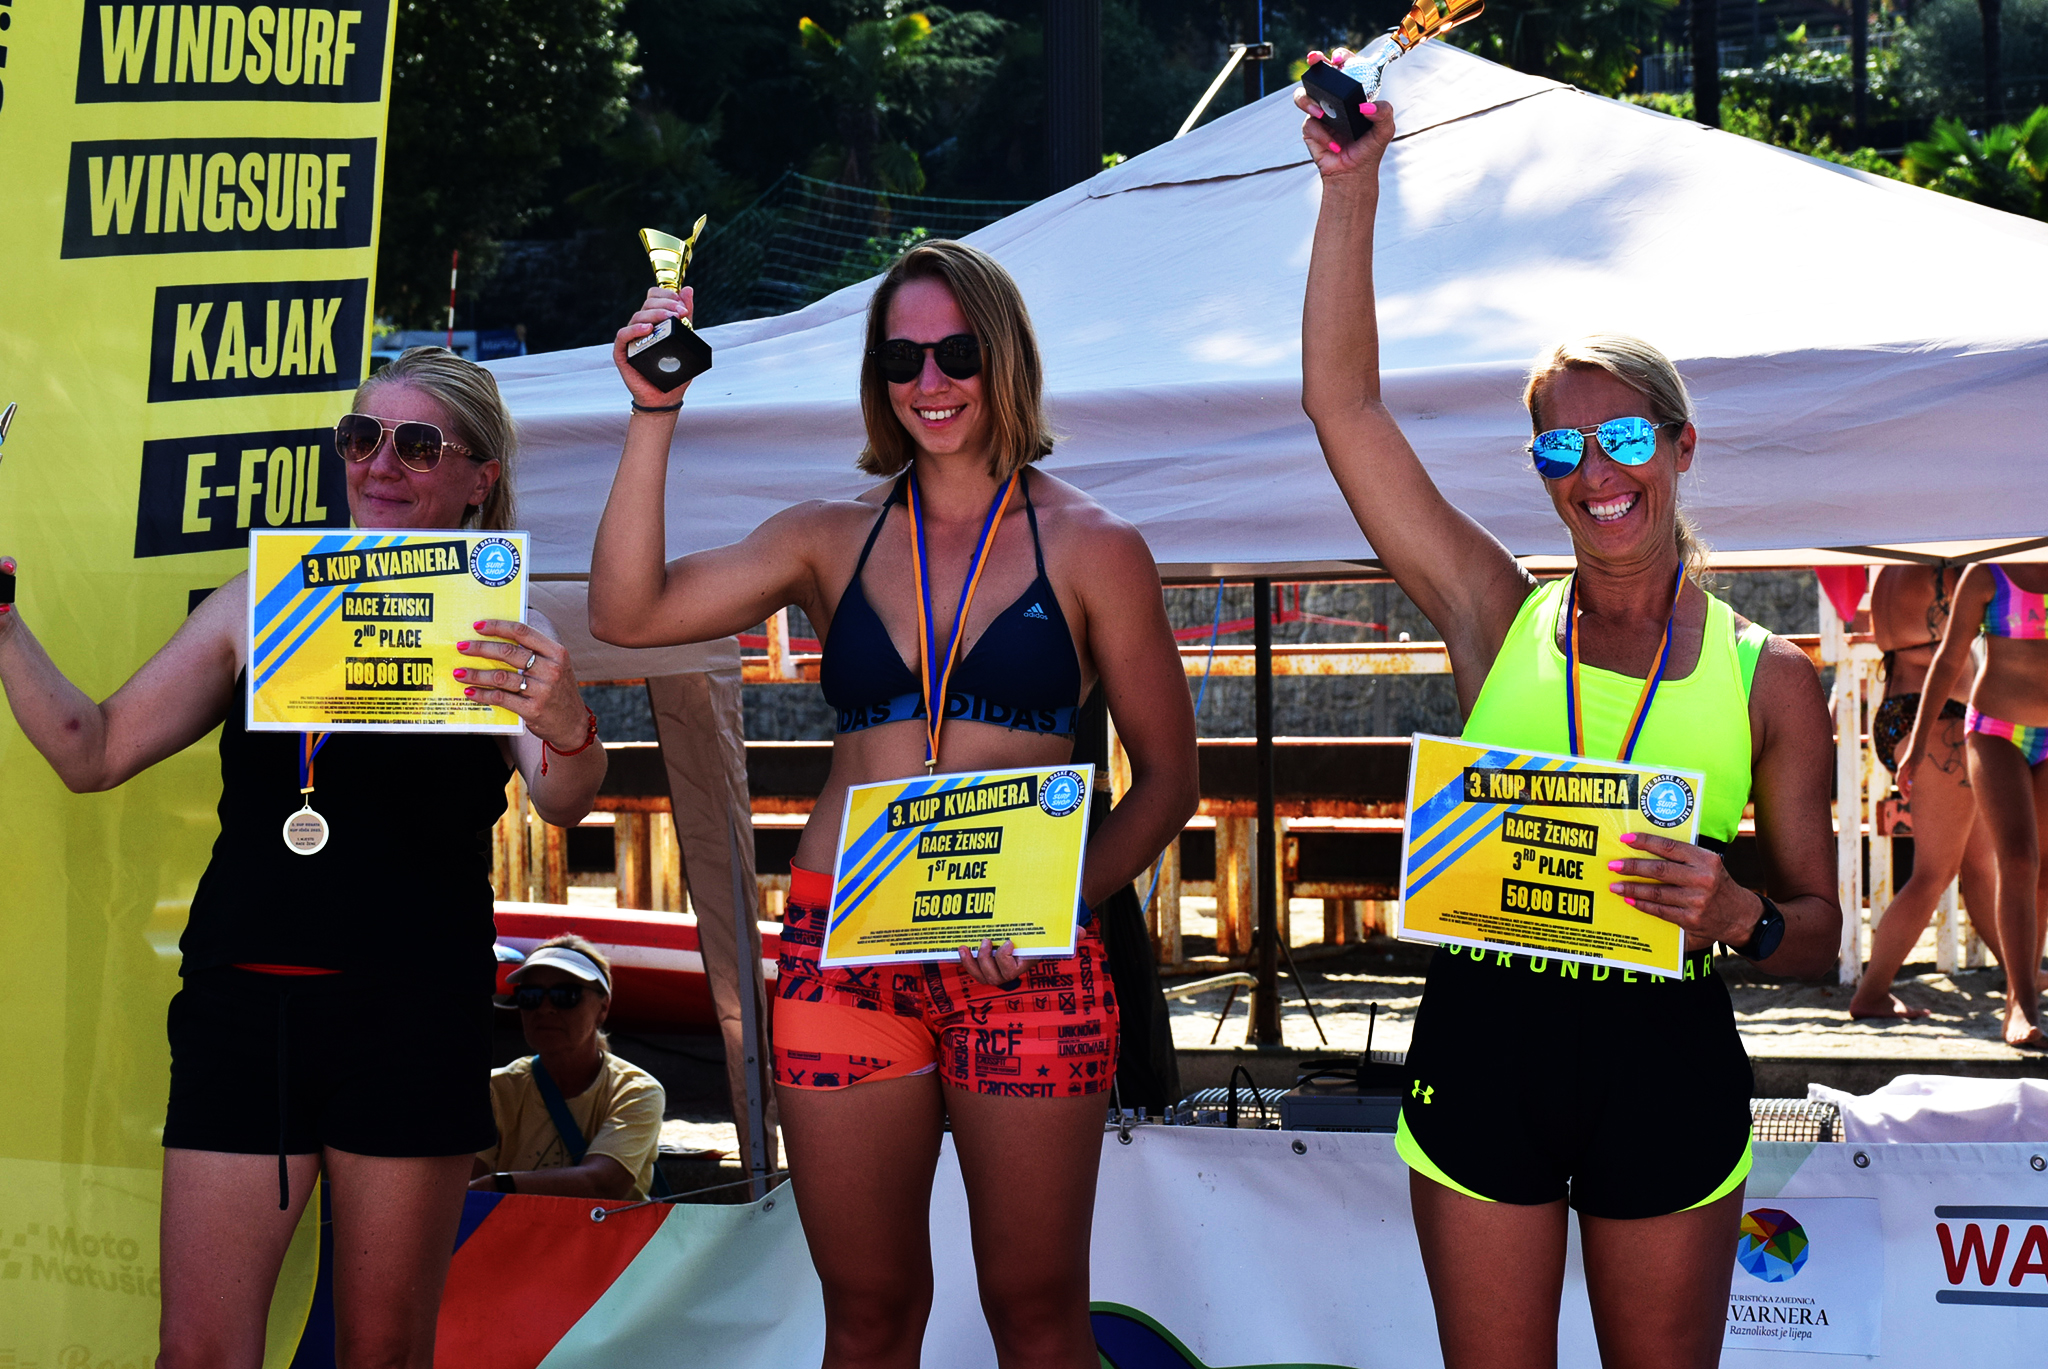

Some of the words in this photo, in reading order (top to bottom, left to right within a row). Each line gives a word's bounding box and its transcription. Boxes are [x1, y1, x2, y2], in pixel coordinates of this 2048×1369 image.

[100, 5, 361, 85] WINDSURF
[89, 152, 350, 236] WINGSURF
[172, 298, 342, 382] KAJAK
[182, 445, 327, 533] E-FOIL
[308, 559, 324, 583] 3.
[327, 556, 361, 580] KUP
[366, 546, 460, 577] KVARNERA
[345, 597, 379, 616] RACE
[382, 594, 430, 617] ŽENSKI
[1023, 612, 1048, 620] adidas
[2007, 608, 2048, 627] MA
[379, 629, 422, 648] PLACE
[345, 662, 398, 688] 100,00
[403, 663, 433, 685] EUR
[911, 692, 1056, 731] ADIDAS
[1469, 773, 1486, 797] 3.
[1490, 774, 1525, 799] KUP
[1530, 776, 1630, 805] KVARNERA
[892, 805, 906, 827] 3.
[909, 799, 941, 823] KUP
[944, 782, 1030, 817] KVARNERA
[921, 834, 952, 854] RACE
[954, 830, 999, 851] ŽENSKI
[1505, 818, 1541, 841] RACE
[1544, 821, 1594, 850] ŽENSKI
[947, 861, 988, 881] PLACE
[1539, 856, 1584, 880] PLACE
[914, 895, 961, 918] 150,00
[965, 892, 995, 914] EUR
[1506, 884, 1553, 914] 50,00
[1558, 892, 1590, 918] EUR
[1440, 942, 1511, 968] OUR
[1029, 973, 1074, 989] FITNESS
[1078, 946, 1095, 1006] CROSSFIT
[954, 1027, 970, 1080] FORGING
[978, 1080, 1056, 1098] CROSSFIT
[48, 1225, 140, 1262] Moto
[1730, 1294, 1774, 1303] TURISTIČKA
[1775, 1296, 1815, 1305] ZAJEDNICA
[1726, 1305, 1830, 1326] VARNERA
[1730, 1325, 1779, 1337] Raznolikost
[1778, 1327, 1788, 1340] je
[1789, 1327, 1812, 1341] lijepa
